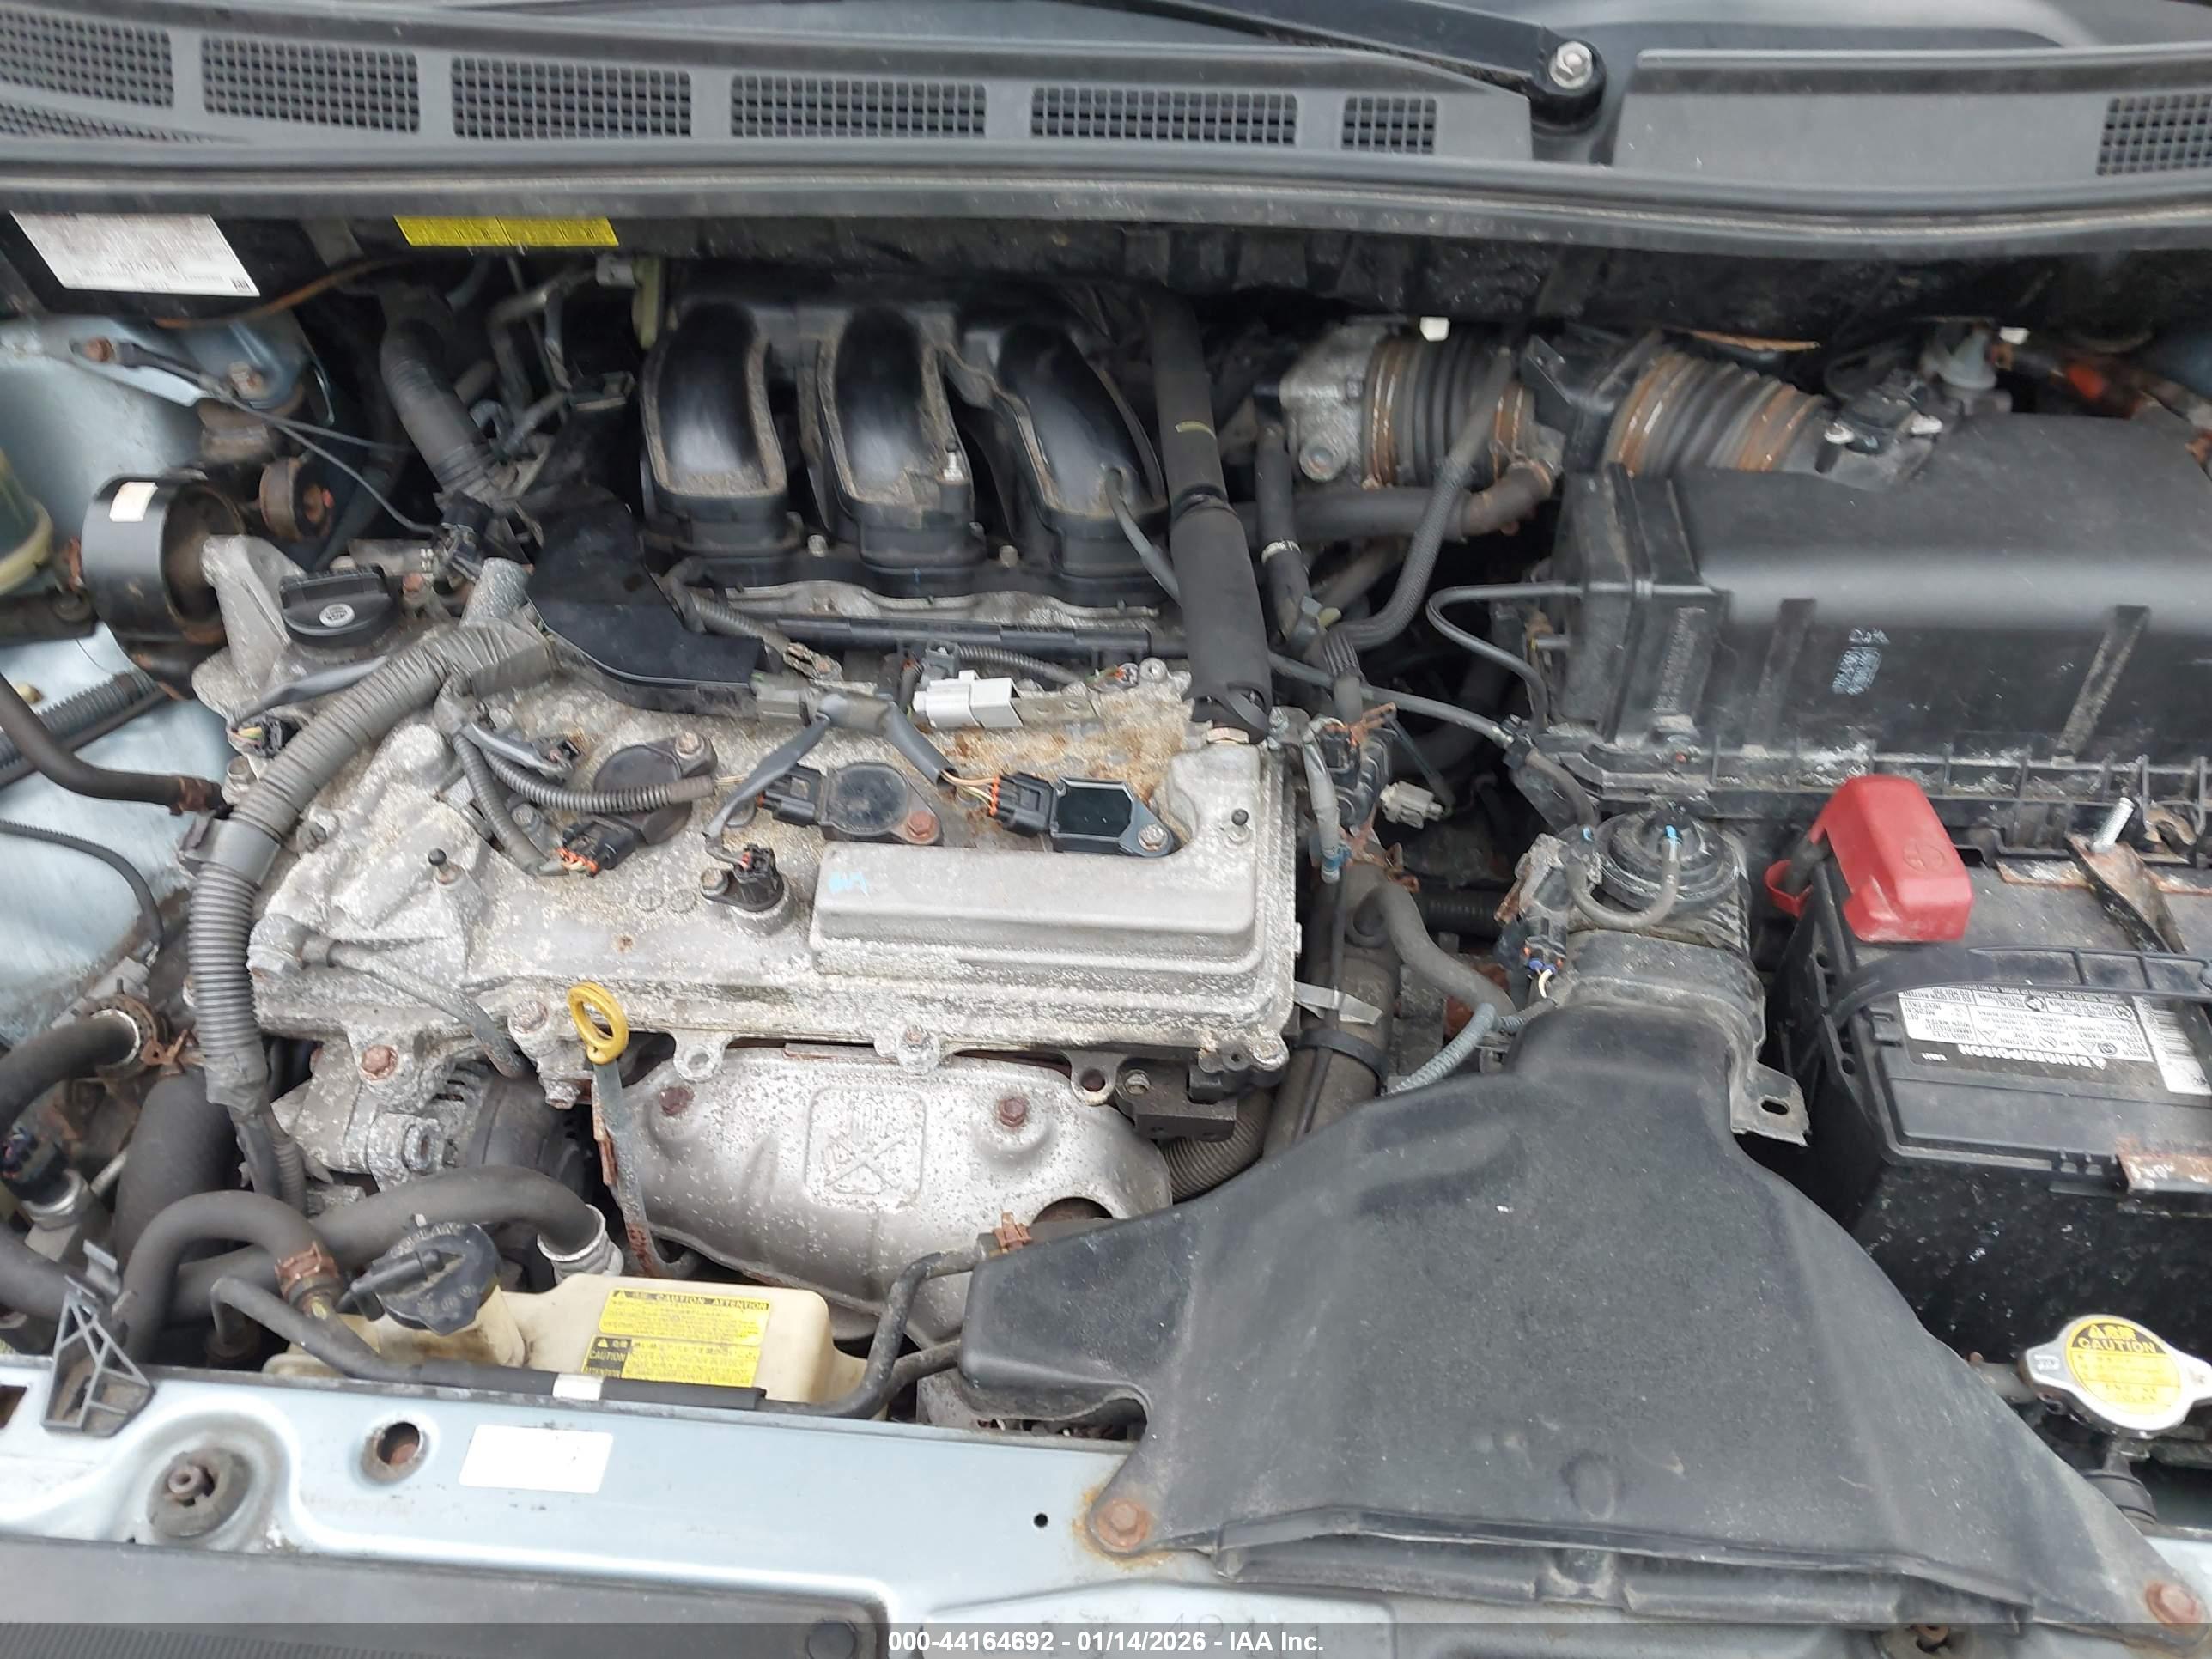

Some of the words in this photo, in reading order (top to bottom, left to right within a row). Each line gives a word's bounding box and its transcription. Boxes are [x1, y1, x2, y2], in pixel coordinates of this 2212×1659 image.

[1957, 1042, 2093, 1068] DANGER/POISON
[656, 1293, 705, 1305] CAUTION
[712, 1297, 768, 1310] ATTENTION
[2078, 1336, 2157, 1354] CAUTION
[589, 1350, 626, 1362] CAUTION
